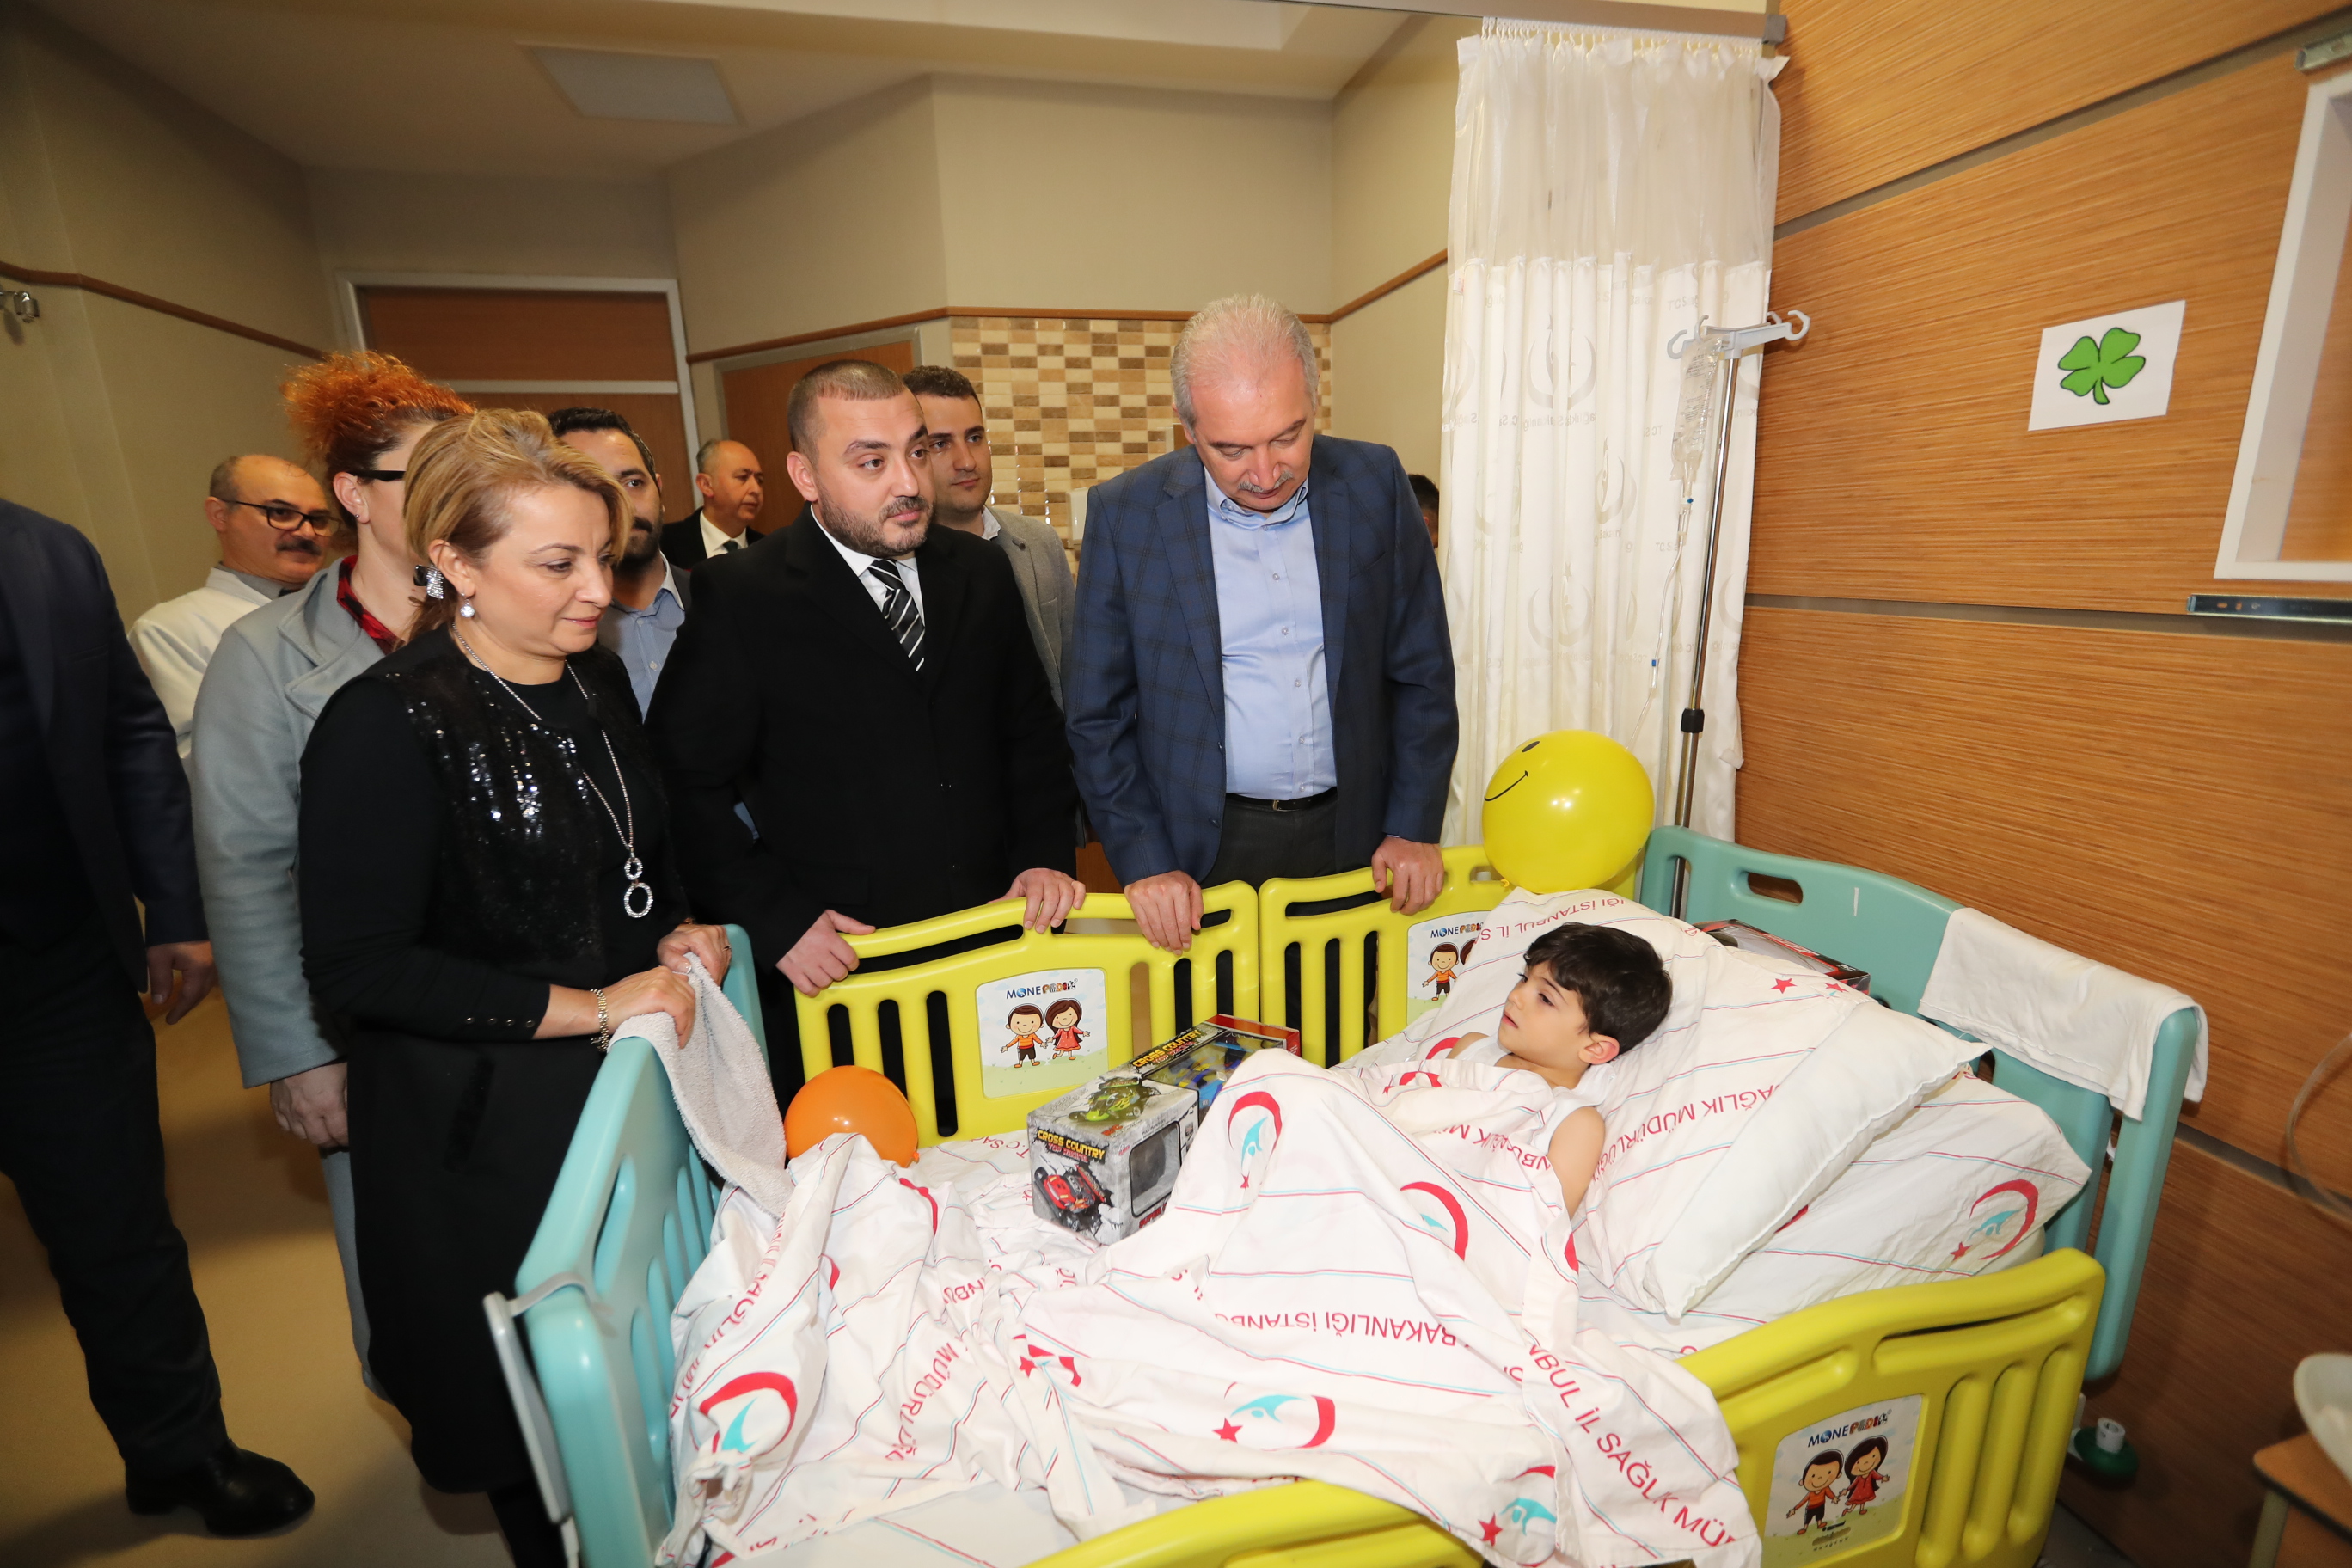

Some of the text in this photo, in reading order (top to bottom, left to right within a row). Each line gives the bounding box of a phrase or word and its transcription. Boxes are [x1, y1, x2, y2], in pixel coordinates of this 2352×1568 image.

[1132, 1049, 1166, 1068] CROSS
[1162, 1029, 1202, 1051] COUNTRY
[1701, 1081, 1780, 1116] AĞLIK
[1038, 1130, 1065, 1147] CROSS
[1065, 1139, 1106, 1160] COUNTRY
